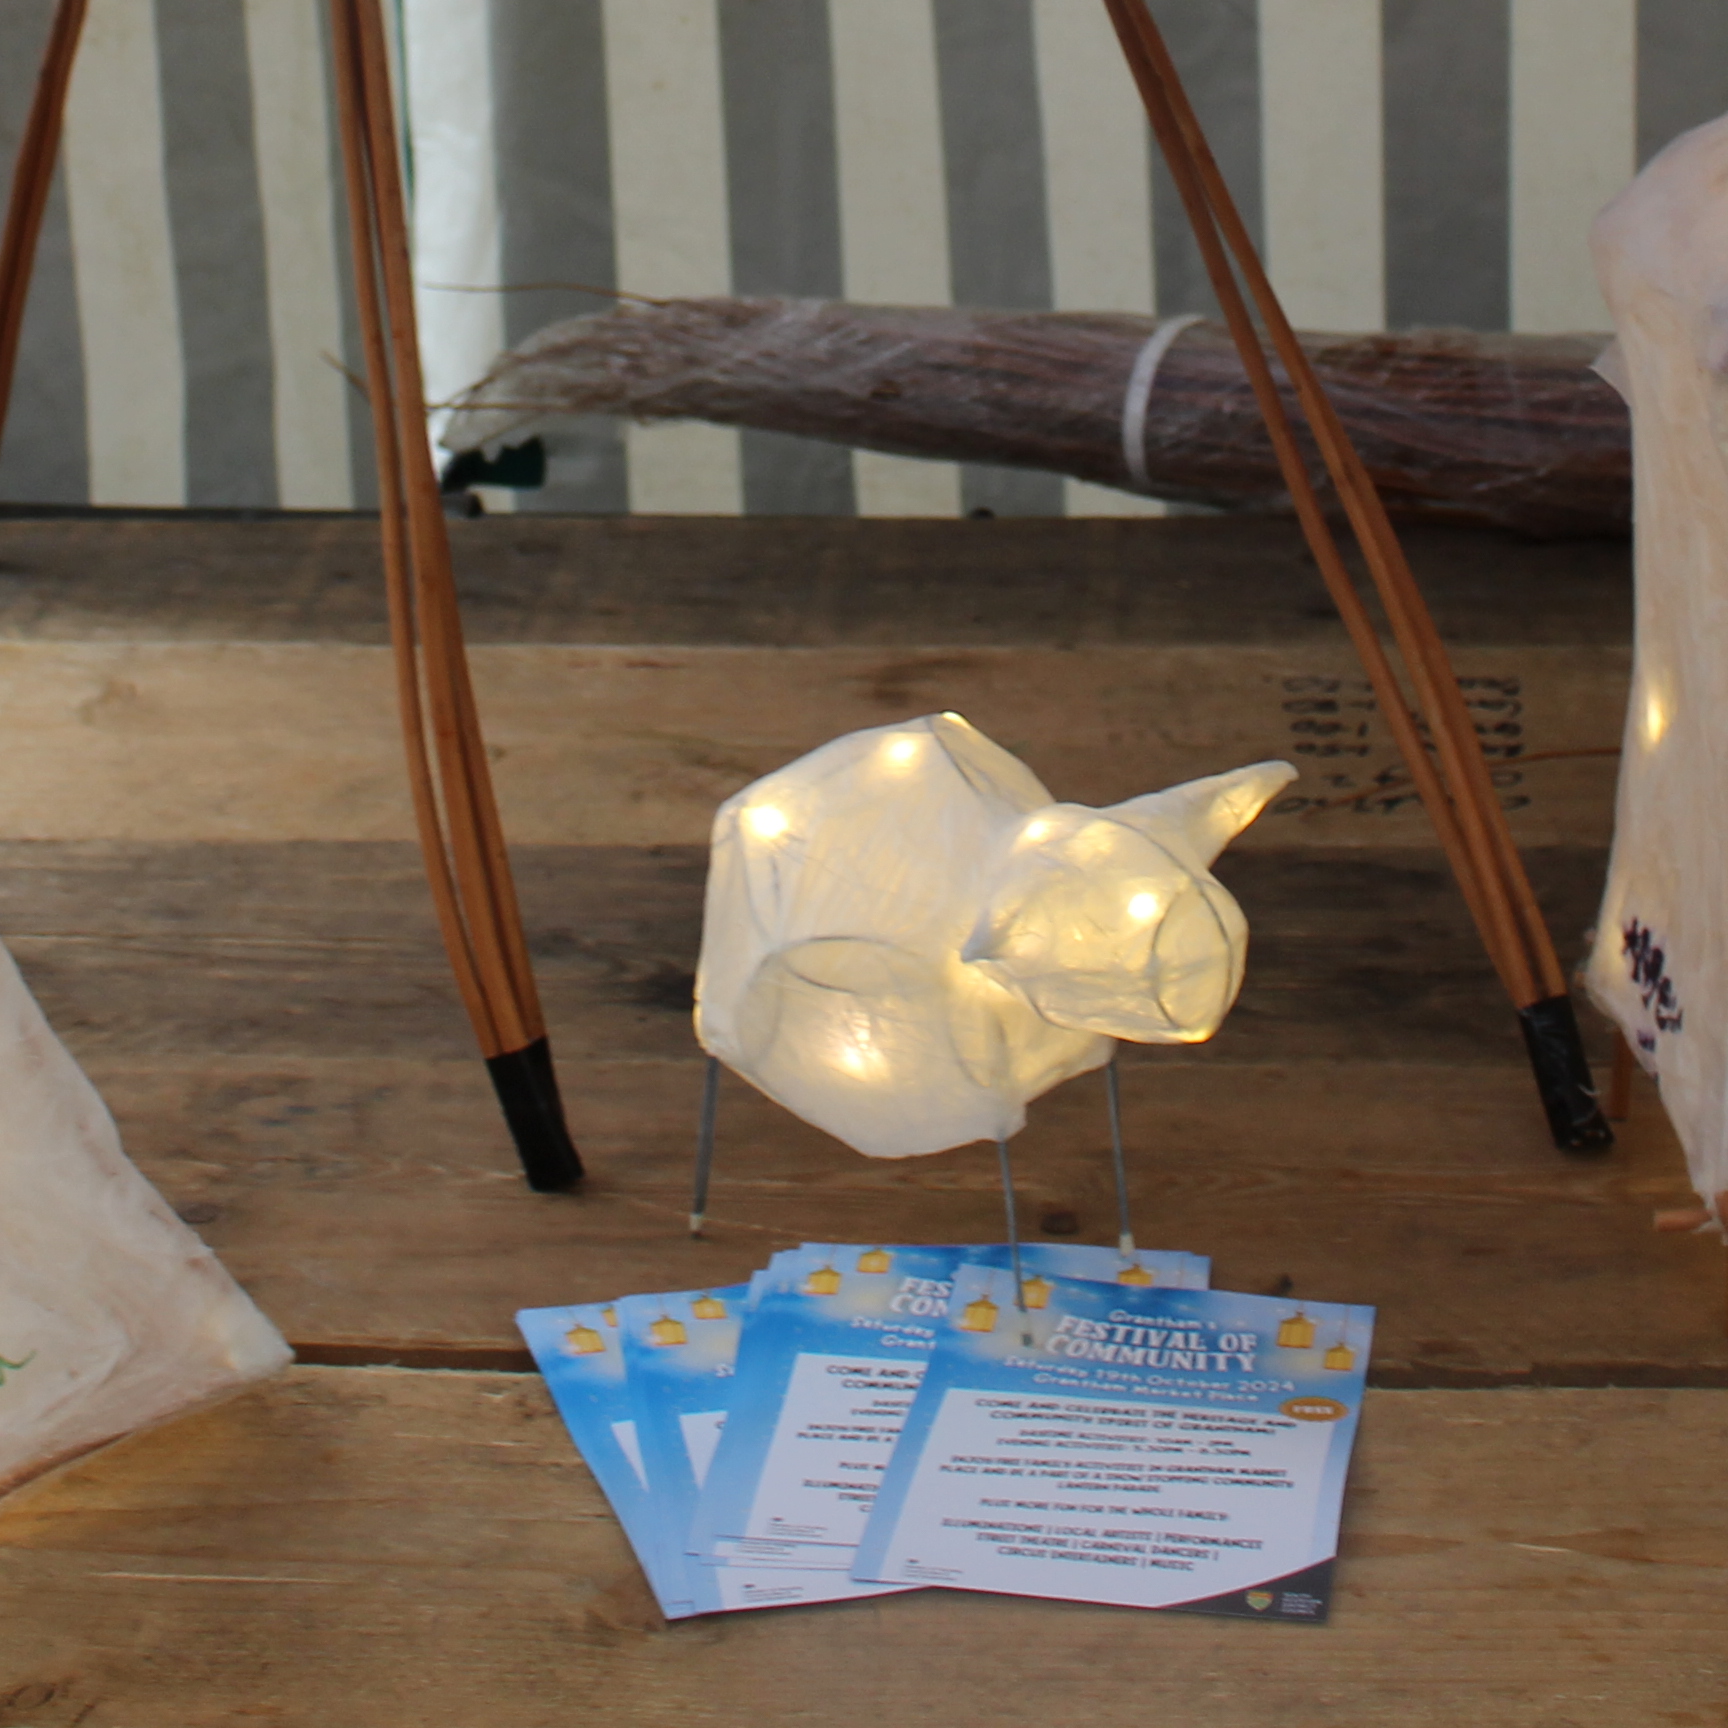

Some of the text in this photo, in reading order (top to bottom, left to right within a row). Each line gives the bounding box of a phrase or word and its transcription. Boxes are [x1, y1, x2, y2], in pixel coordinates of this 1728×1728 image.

[1055, 1315, 1258, 1353] FESTIVAL OF
[1045, 1334, 1257, 1373] COMMUNITY
[1004, 1355, 1296, 1393] Saturday 19th October 2024
[1033, 1372, 1260, 1403] Grantham Market Place
[975, 1398, 1021, 1410] COME
[1065, 1404, 1147, 1418] CELEBRATE
[989, 1410, 1094, 1424] COMMUNITY
[1292, 1404, 1335, 1416] FREE
